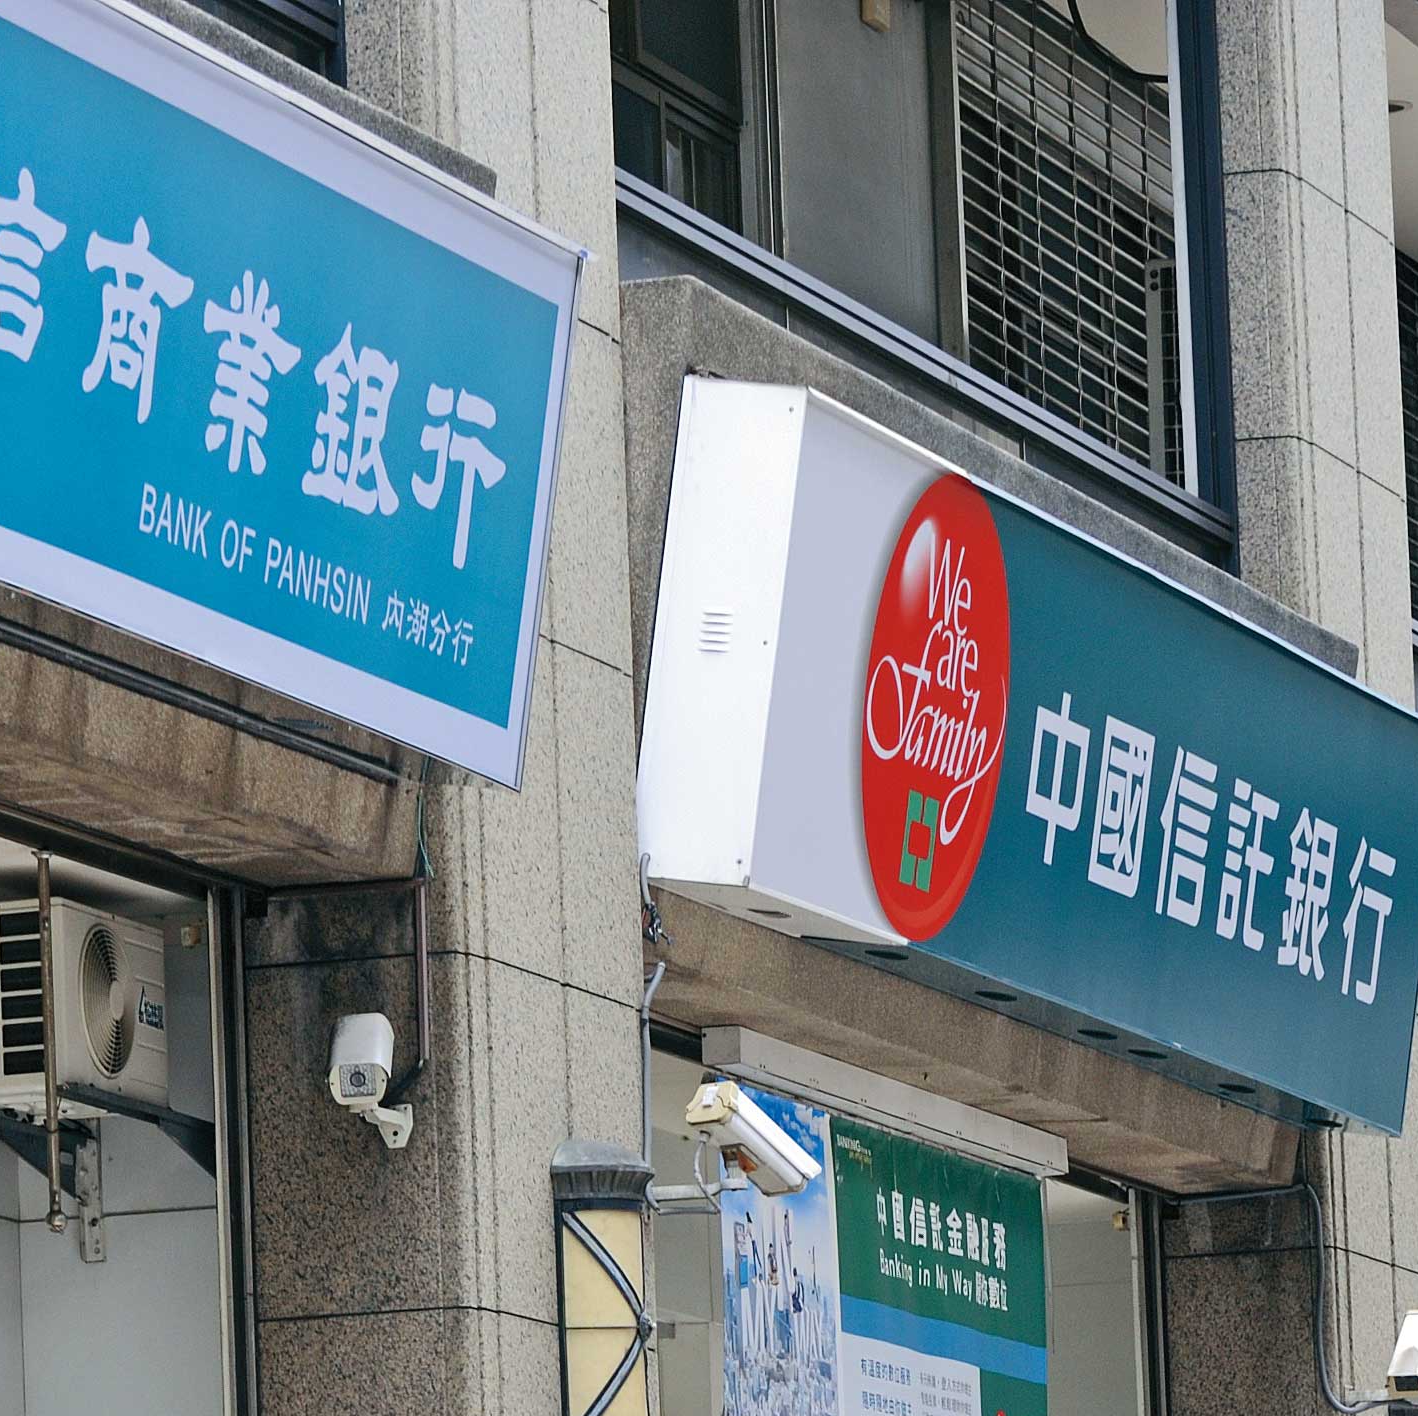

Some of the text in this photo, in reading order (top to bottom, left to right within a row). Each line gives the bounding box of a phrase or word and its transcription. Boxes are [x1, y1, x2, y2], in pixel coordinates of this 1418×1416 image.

[138, 482, 372, 628] BANK OF PANHSIN
[927, 537, 973, 637] We
[384, 588, 476, 670] 內湖分行
[935, 632, 980, 697] are
[866, 622, 1009, 845] Family
[1025, 691, 1398, 1006] 中國信託銀行
[879, 1248, 913, 1288] Banking
[918, 1260, 931, 1287] in
[935, 1264, 948, 1296] My
[952, 1268, 972, 1302] Way
